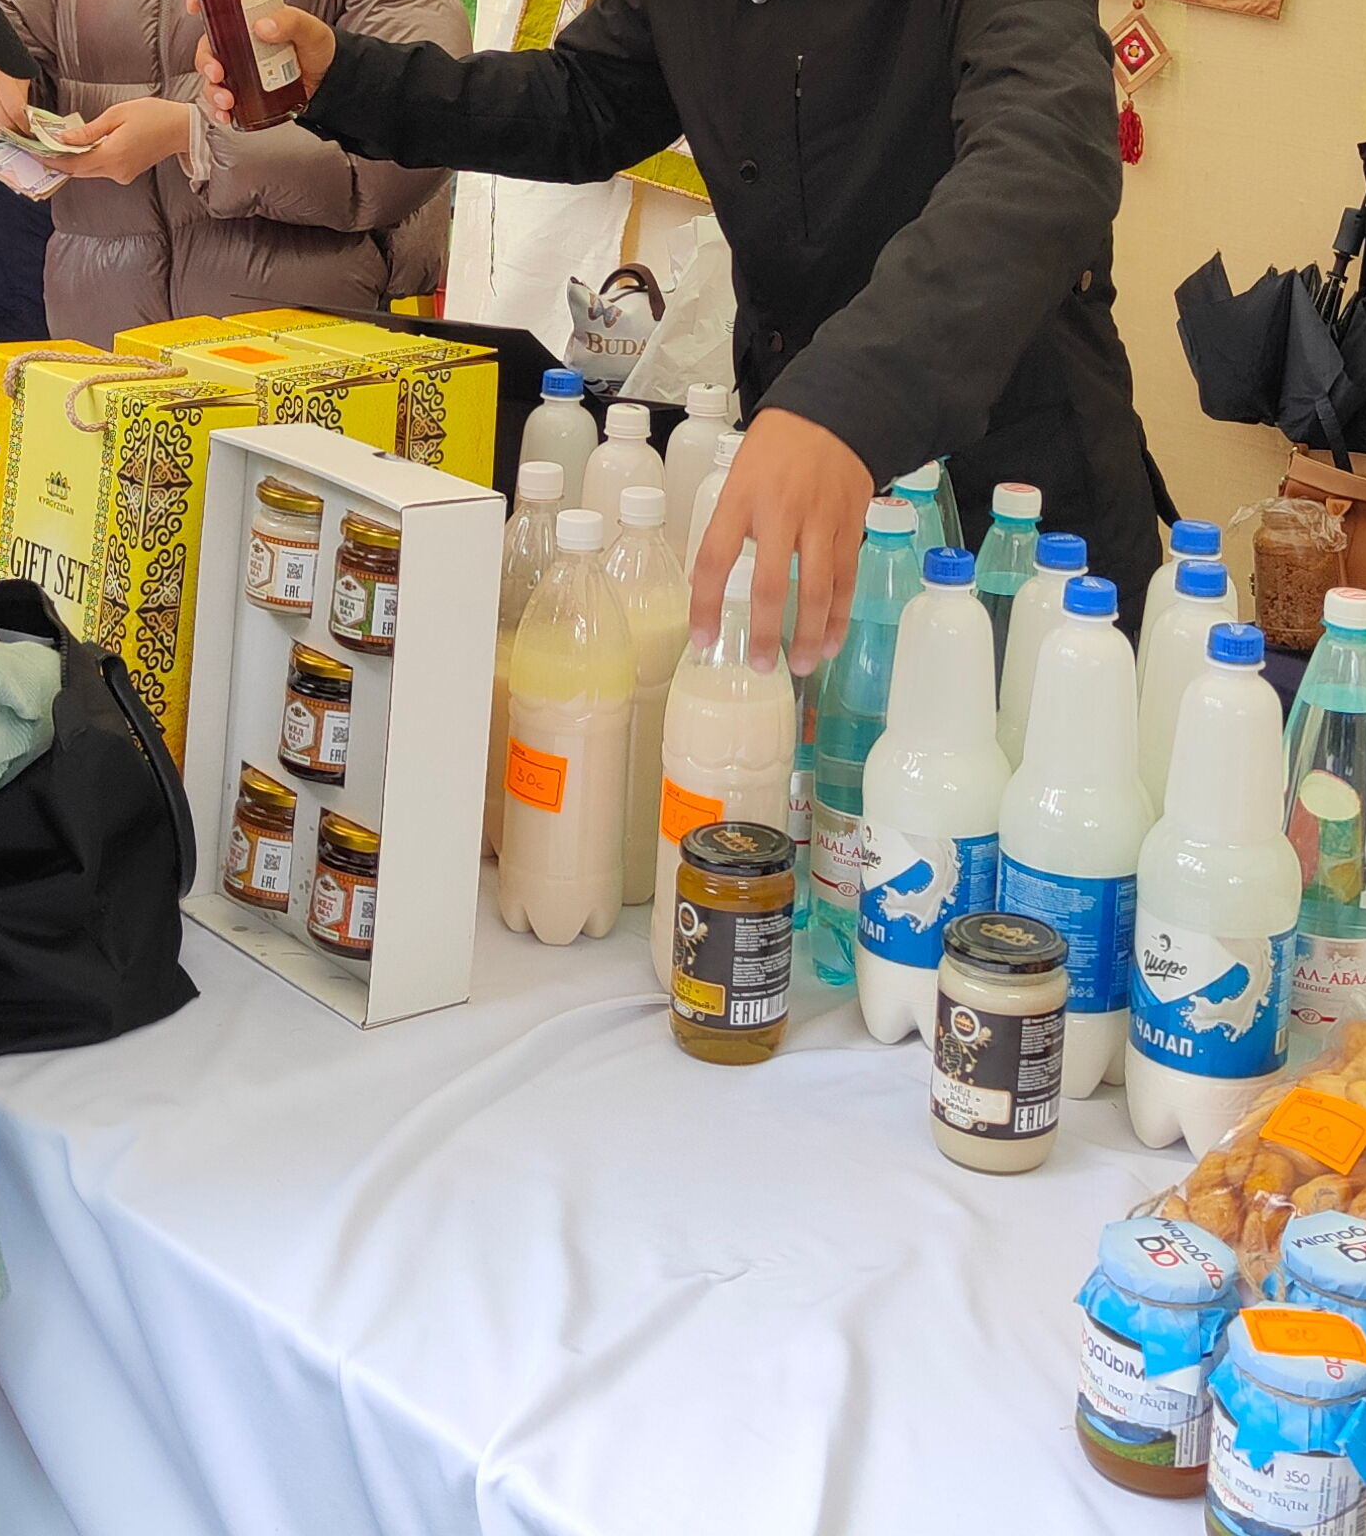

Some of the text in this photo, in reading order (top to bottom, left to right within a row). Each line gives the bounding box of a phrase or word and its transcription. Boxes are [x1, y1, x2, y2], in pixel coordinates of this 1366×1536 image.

[10, 536, 90, 605] GIFT SET
[1135, 1014, 1193, 1059] ЧАЛАП
